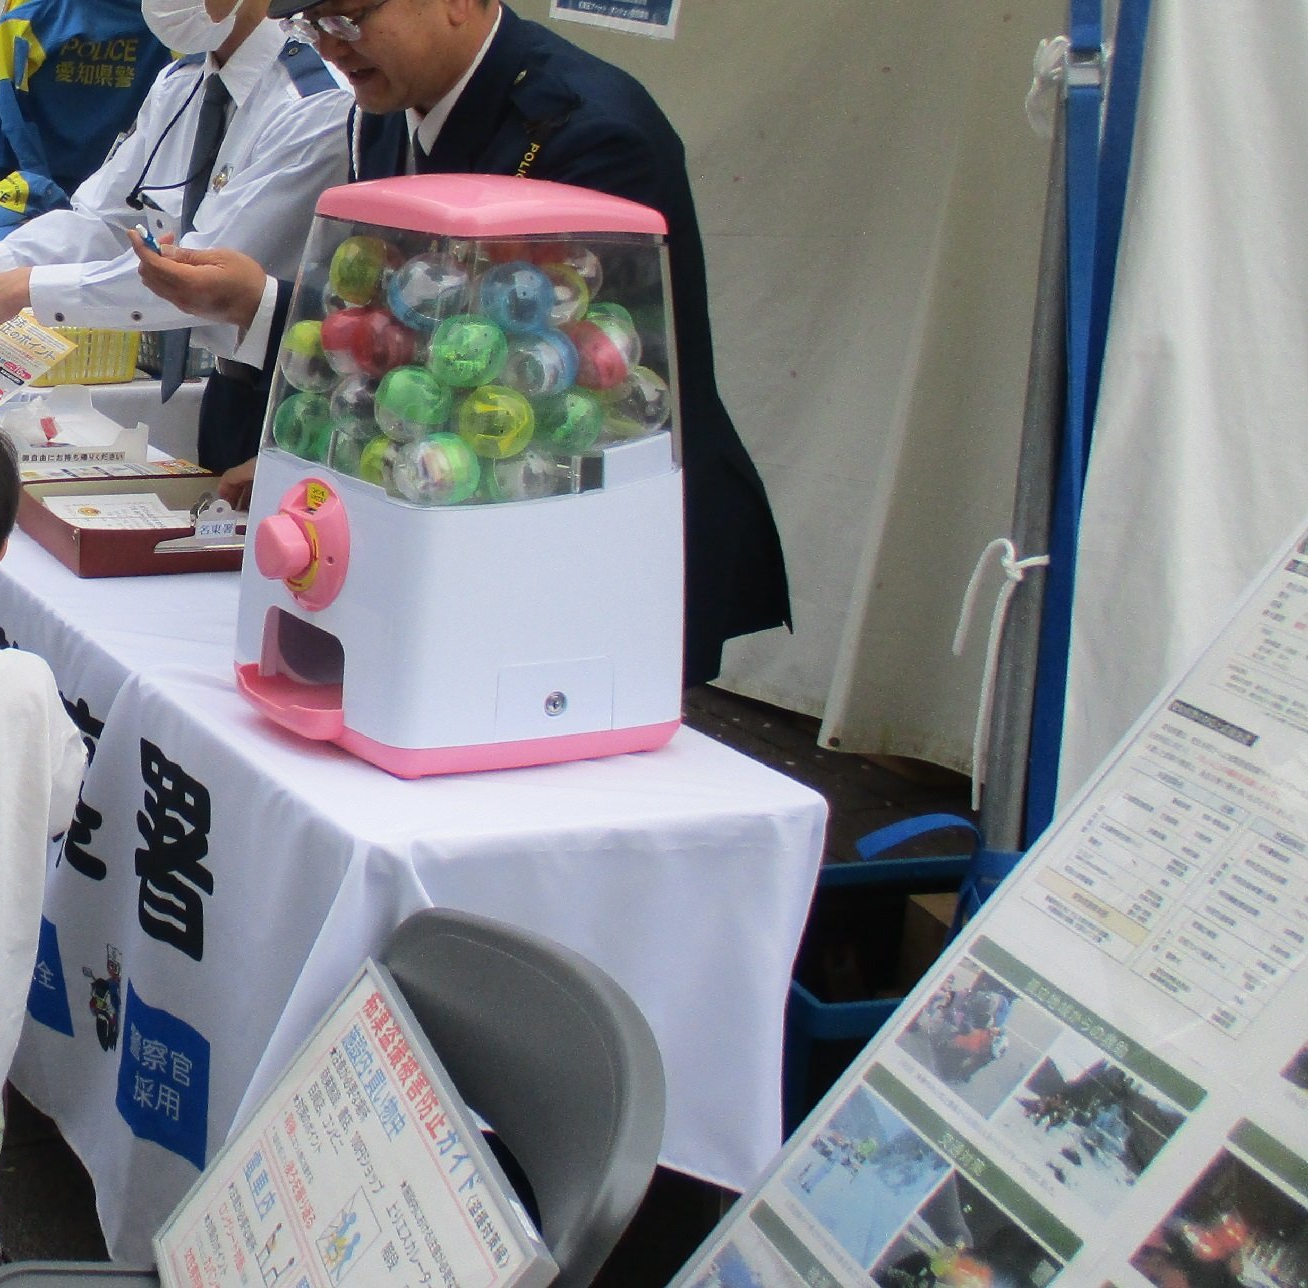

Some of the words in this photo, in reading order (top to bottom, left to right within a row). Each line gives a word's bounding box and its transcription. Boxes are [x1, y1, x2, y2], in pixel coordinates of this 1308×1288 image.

[60, 37, 140, 62] POLICE
[55, 61, 136, 88] 愛知県警
[22, 451, 126, 463] 御自由にお持ち帰りください
[199, 522, 234, 536] 名東署
[132, 1072, 181, 1122] 採用
[360, 988, 481, 1200] 痴漢盗撮被害防止ガイド
[242, 1148, 277, 1222] 電車内
